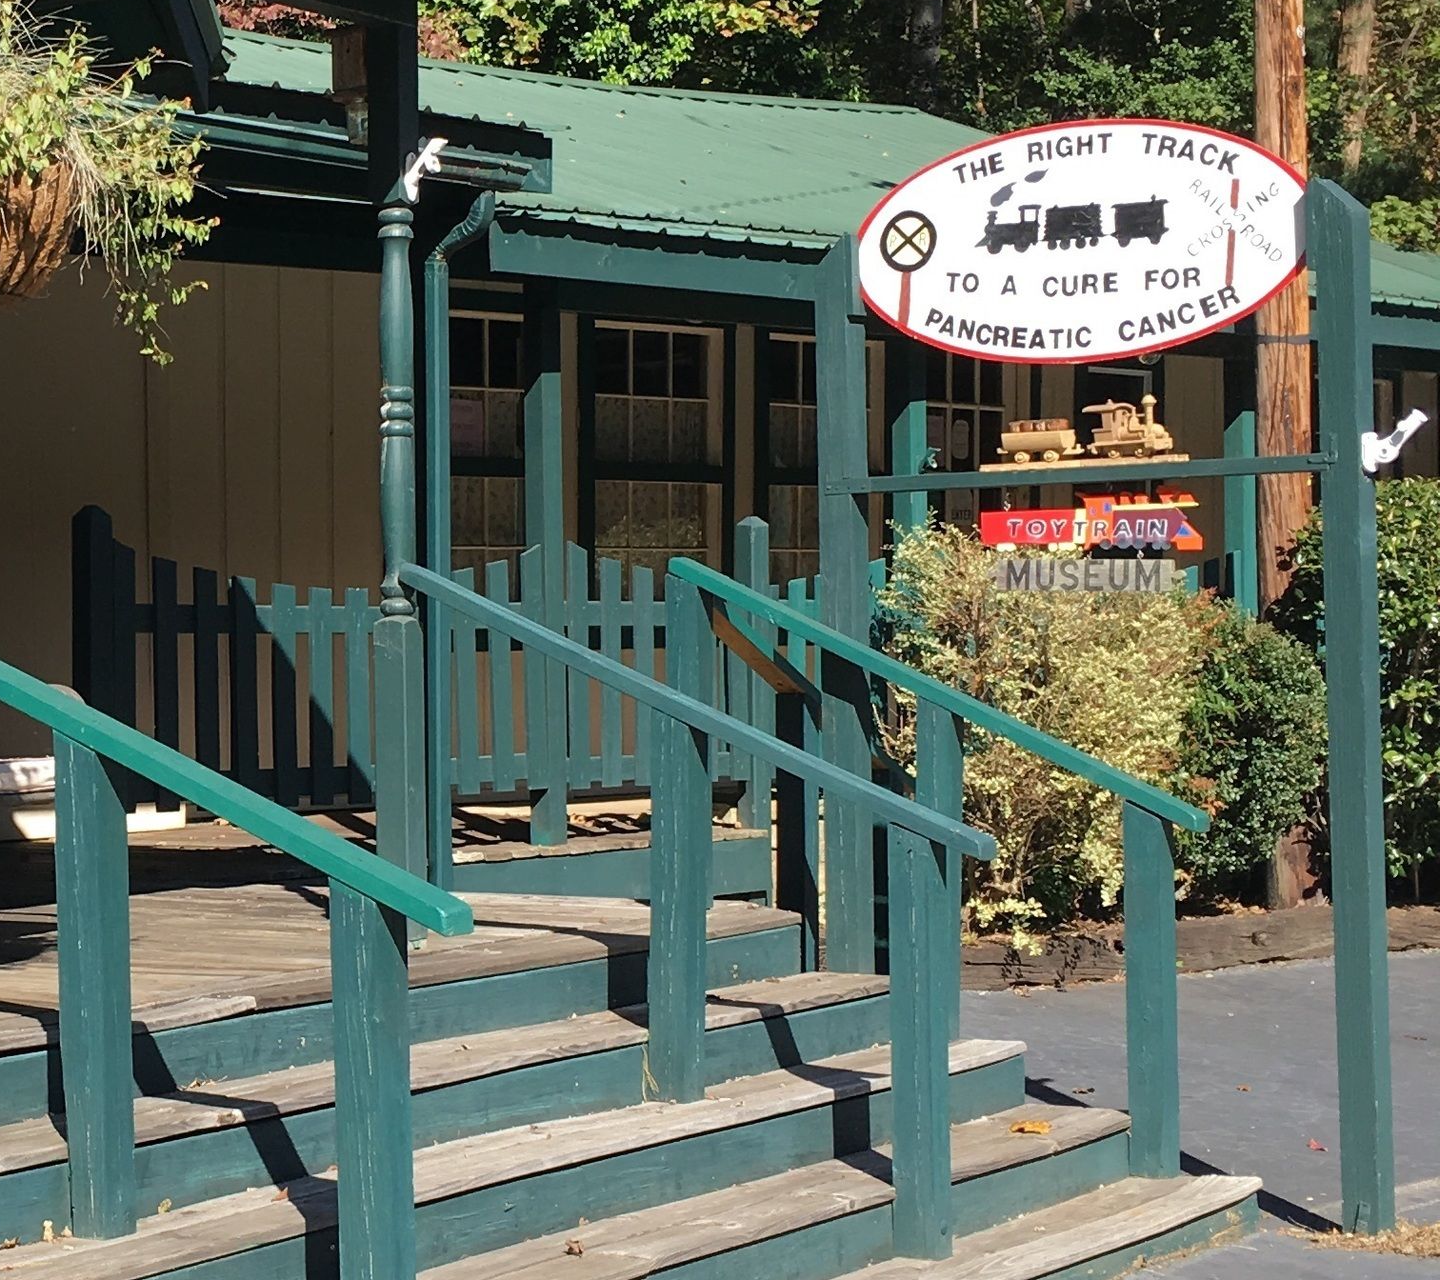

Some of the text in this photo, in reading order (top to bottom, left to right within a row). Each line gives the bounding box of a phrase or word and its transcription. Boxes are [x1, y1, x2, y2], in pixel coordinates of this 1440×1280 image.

[952, 132, 1240, 184] THE RIGHT TRACK
[946, 267, 1201, 297] TO A CURE FOR
[925, 285, 1240, 349] PANCREATIC CANCER
[1006, 559, 1161, 592] MUSEUM
